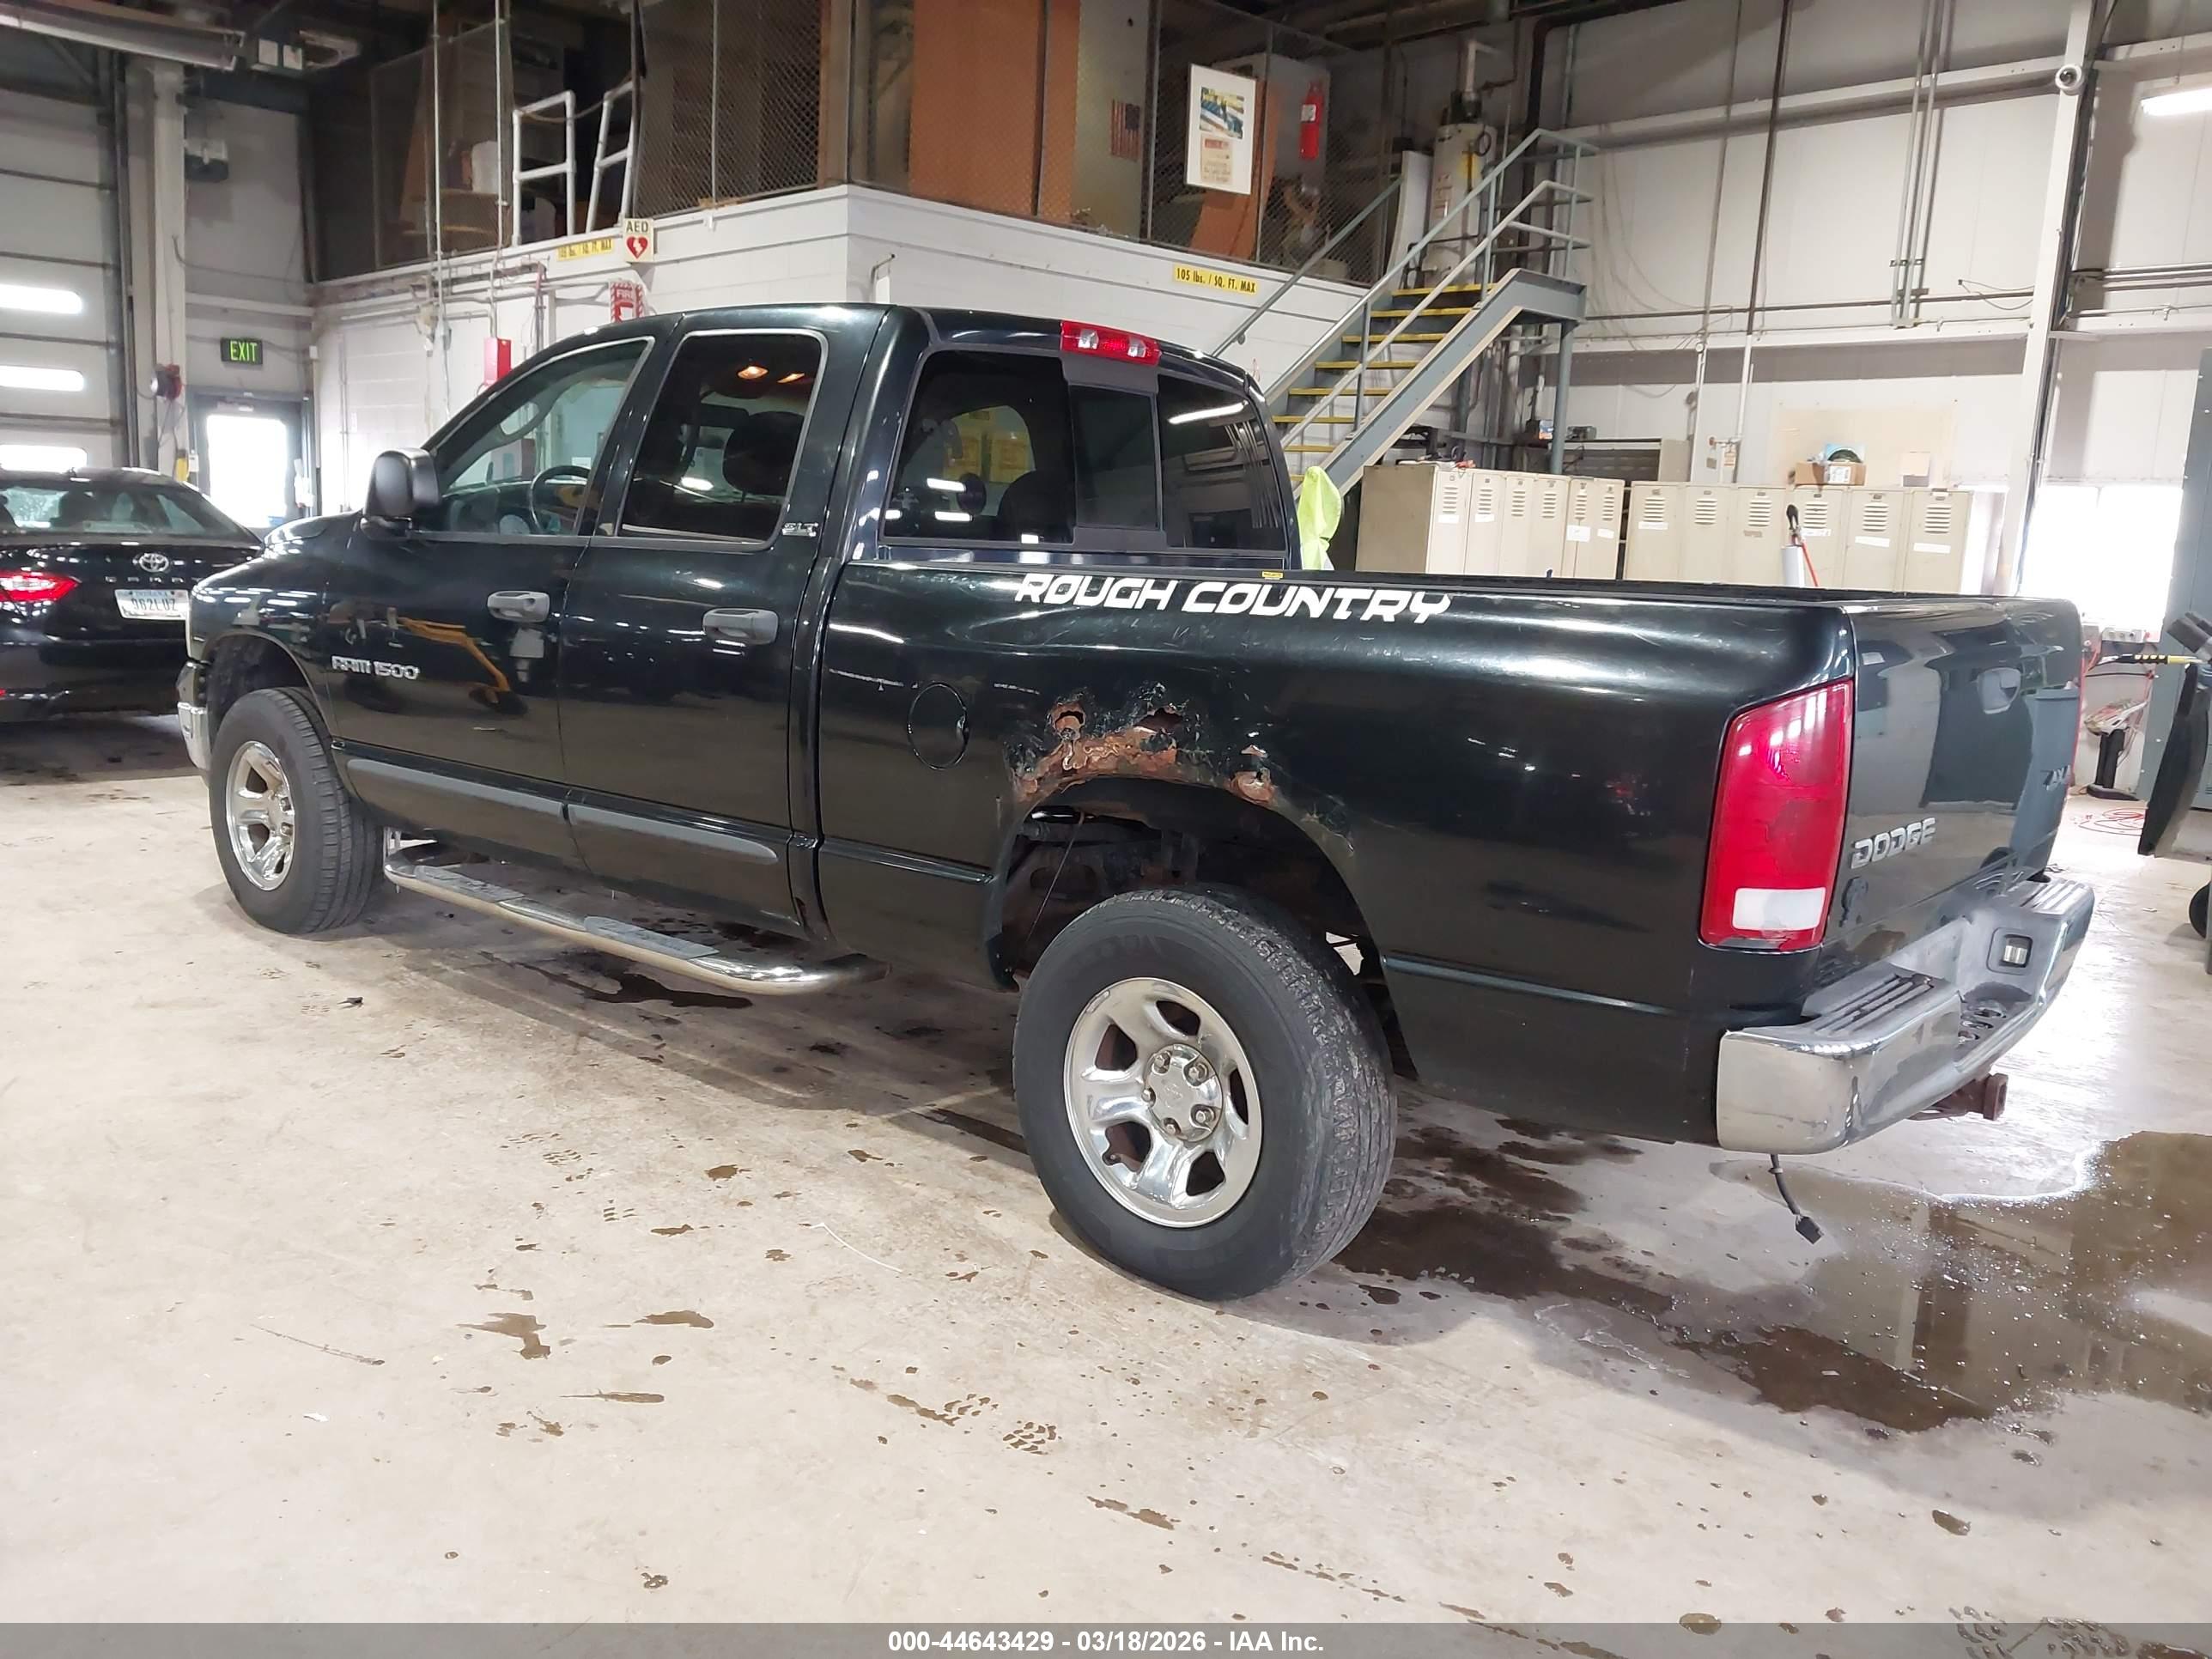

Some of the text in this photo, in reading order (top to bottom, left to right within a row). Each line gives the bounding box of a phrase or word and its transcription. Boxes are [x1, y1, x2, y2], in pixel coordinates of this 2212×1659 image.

[626, 221, 649, 233] AED
[1176, 268, 1190, 281] 105
[1193, 270, 1206, 283] lbs.
[1214, 275, 1225, 288] SQ.
[1228, 278, 1237, 290] FT.
[1240, 281, 1255, 293] MAX
[230, 340, 258, 362] EXIT
[1015, 573, 1451, 623] ROUGH COUNTRY
[331, 655, 420, 681] RAM 1500
[1851, 817, 1936, 869] DODGE
